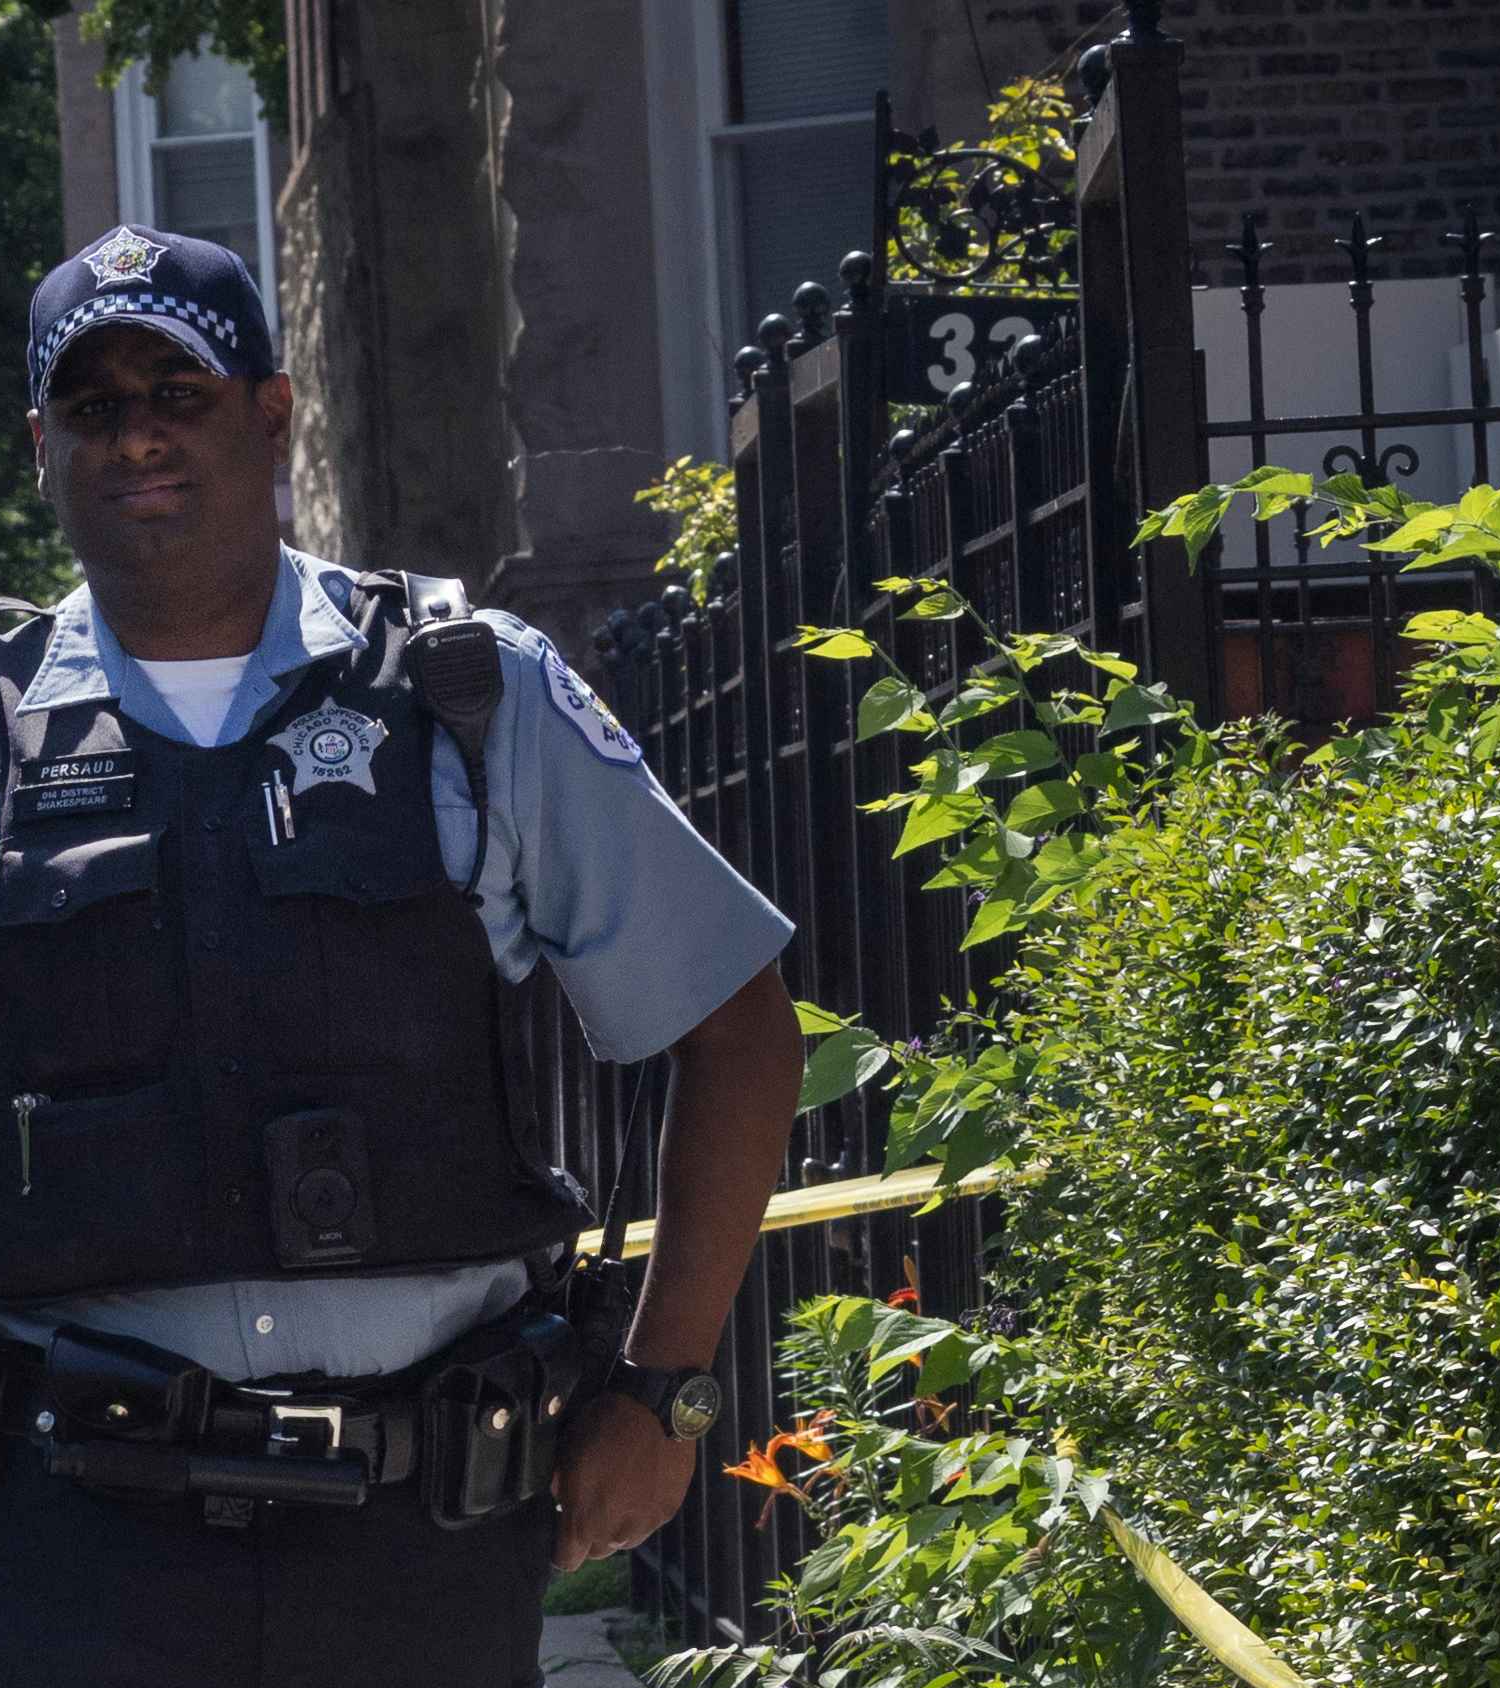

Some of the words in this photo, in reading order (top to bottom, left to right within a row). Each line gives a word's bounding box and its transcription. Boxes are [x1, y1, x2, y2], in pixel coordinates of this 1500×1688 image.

[293, 717, 332, 756] CHICAGO
[339, 720, 371, 752] POLICE
[40, 760, 115, 779] PERSAUD
[61, 786, 105, 798] DISTRICT
[36, 795, 107, 811] SHAKESPEARE
